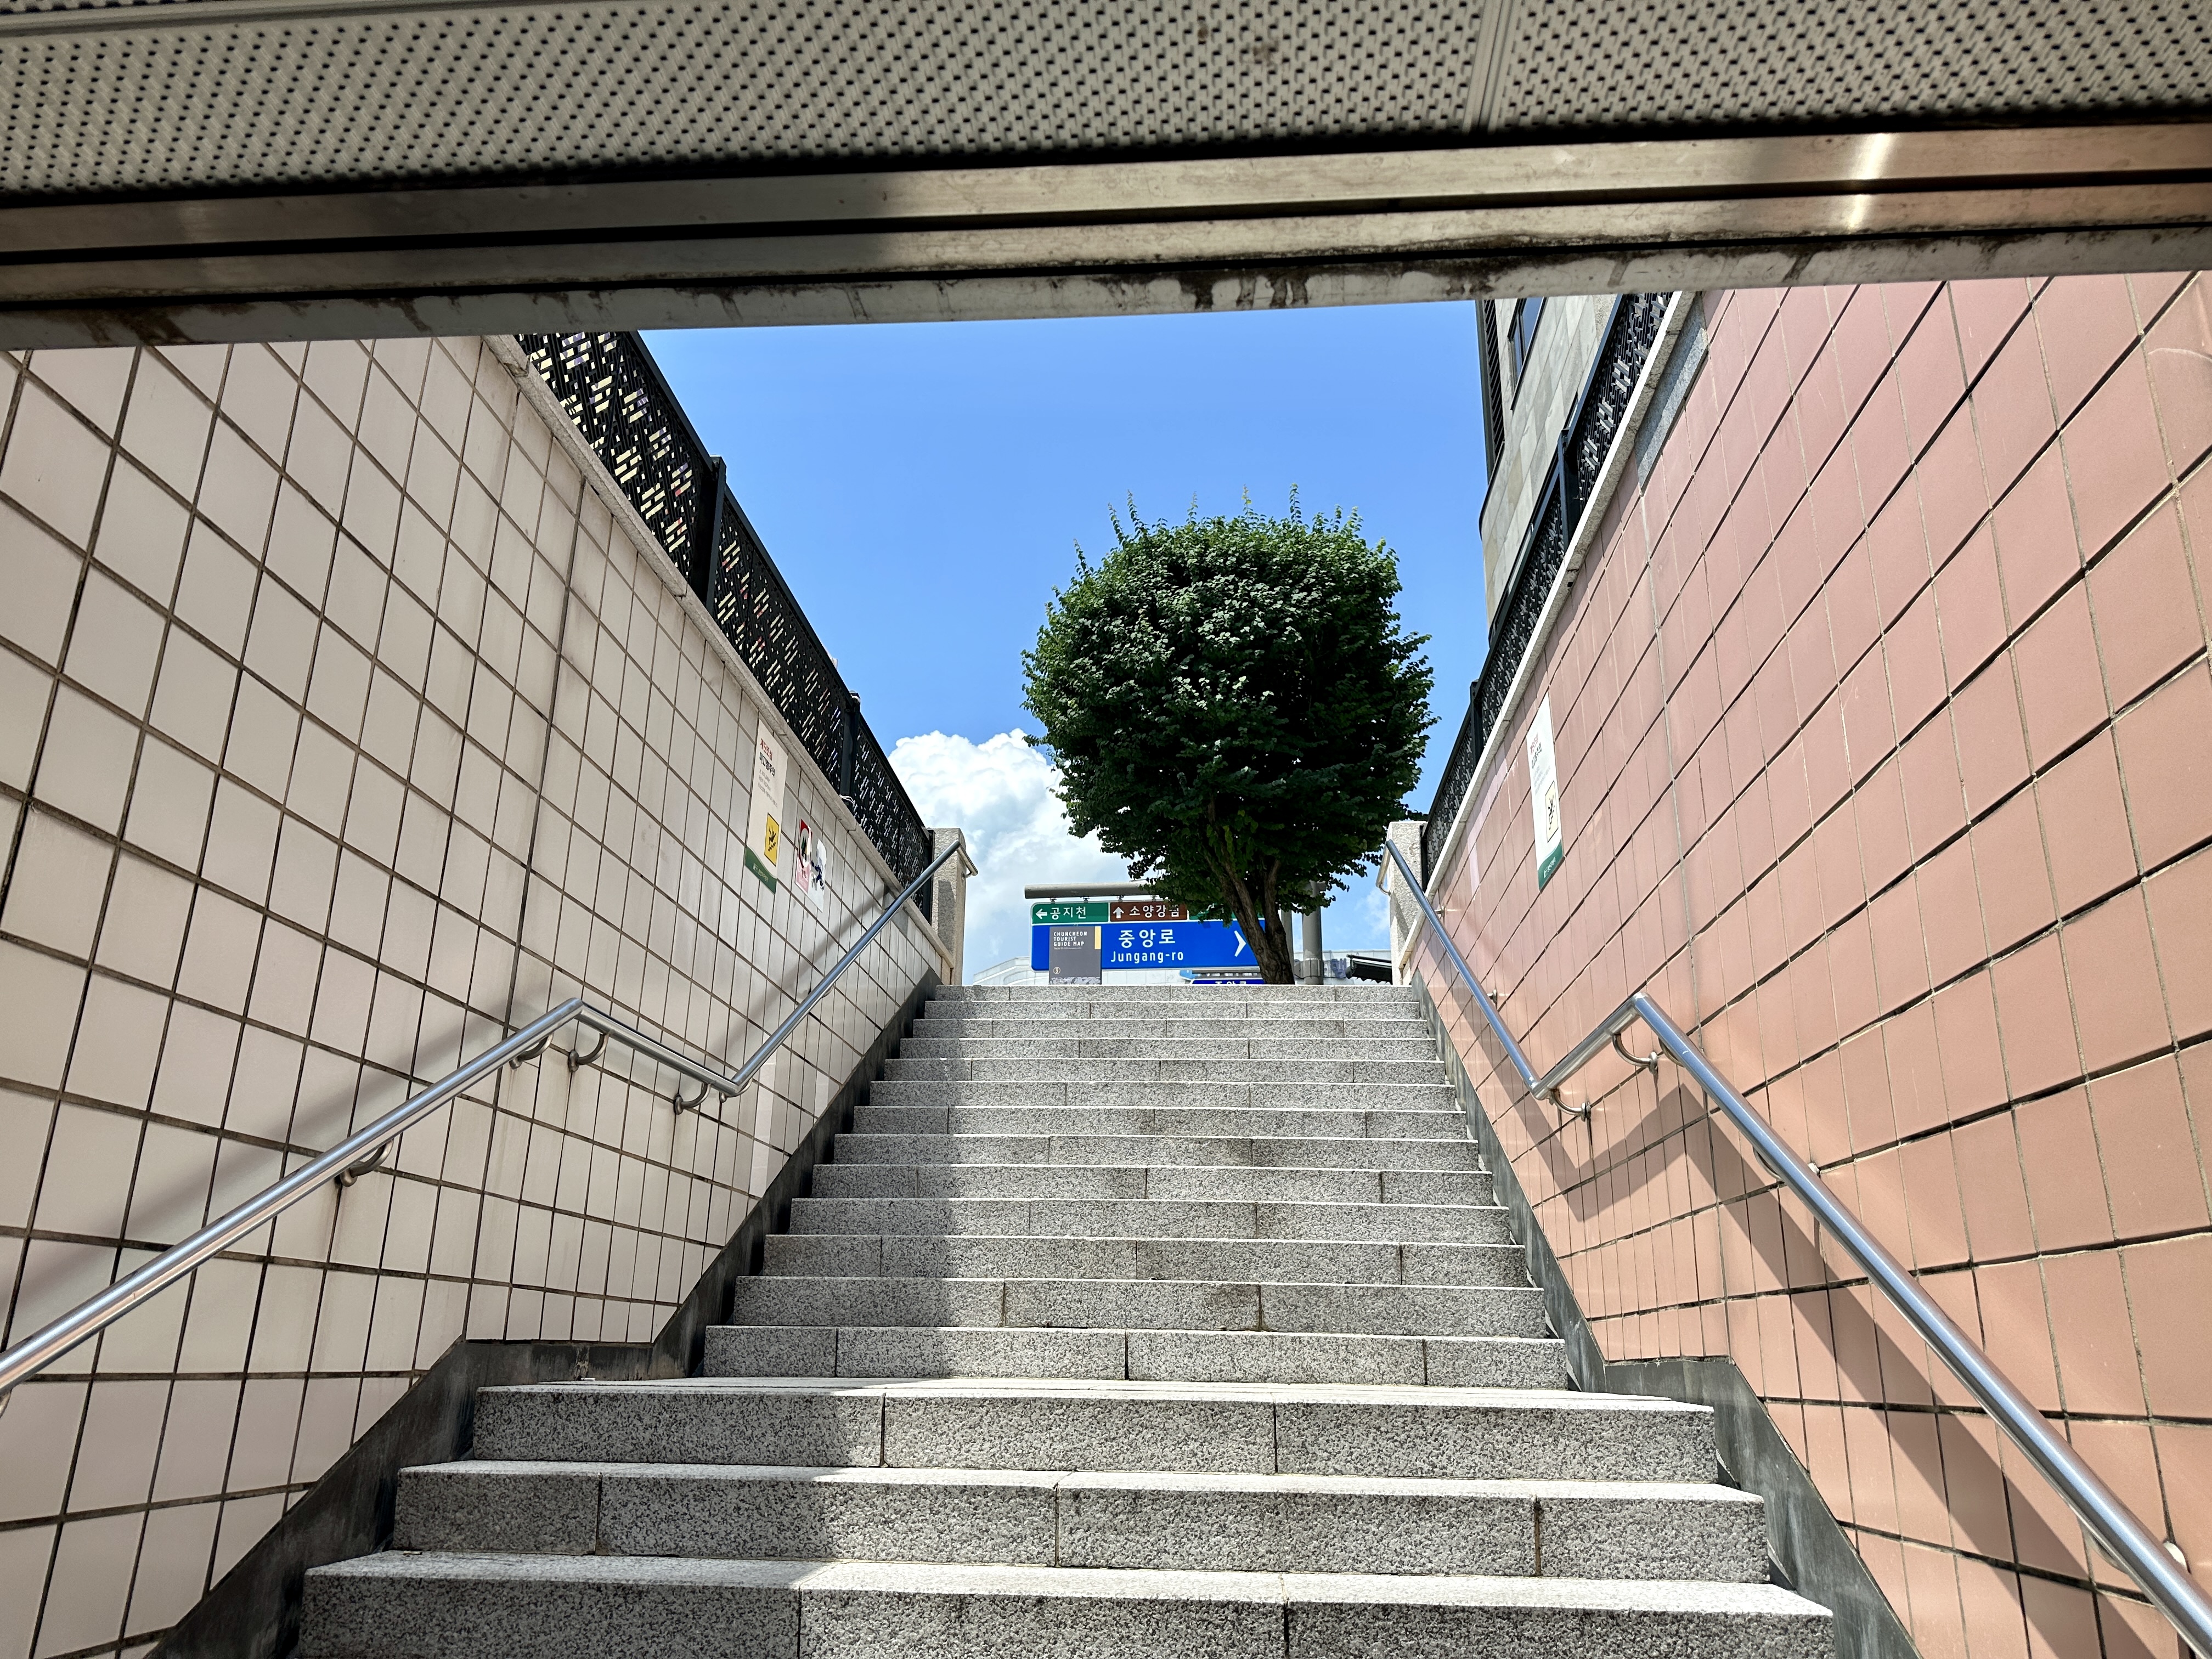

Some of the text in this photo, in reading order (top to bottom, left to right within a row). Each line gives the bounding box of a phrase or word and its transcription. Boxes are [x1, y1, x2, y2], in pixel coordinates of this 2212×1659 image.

[1049, 906, 1086, 920] 공지천
[1118, 929, 1176, 948] 중앙로
[1111, 951, 1184, 963] Jungang-ro
